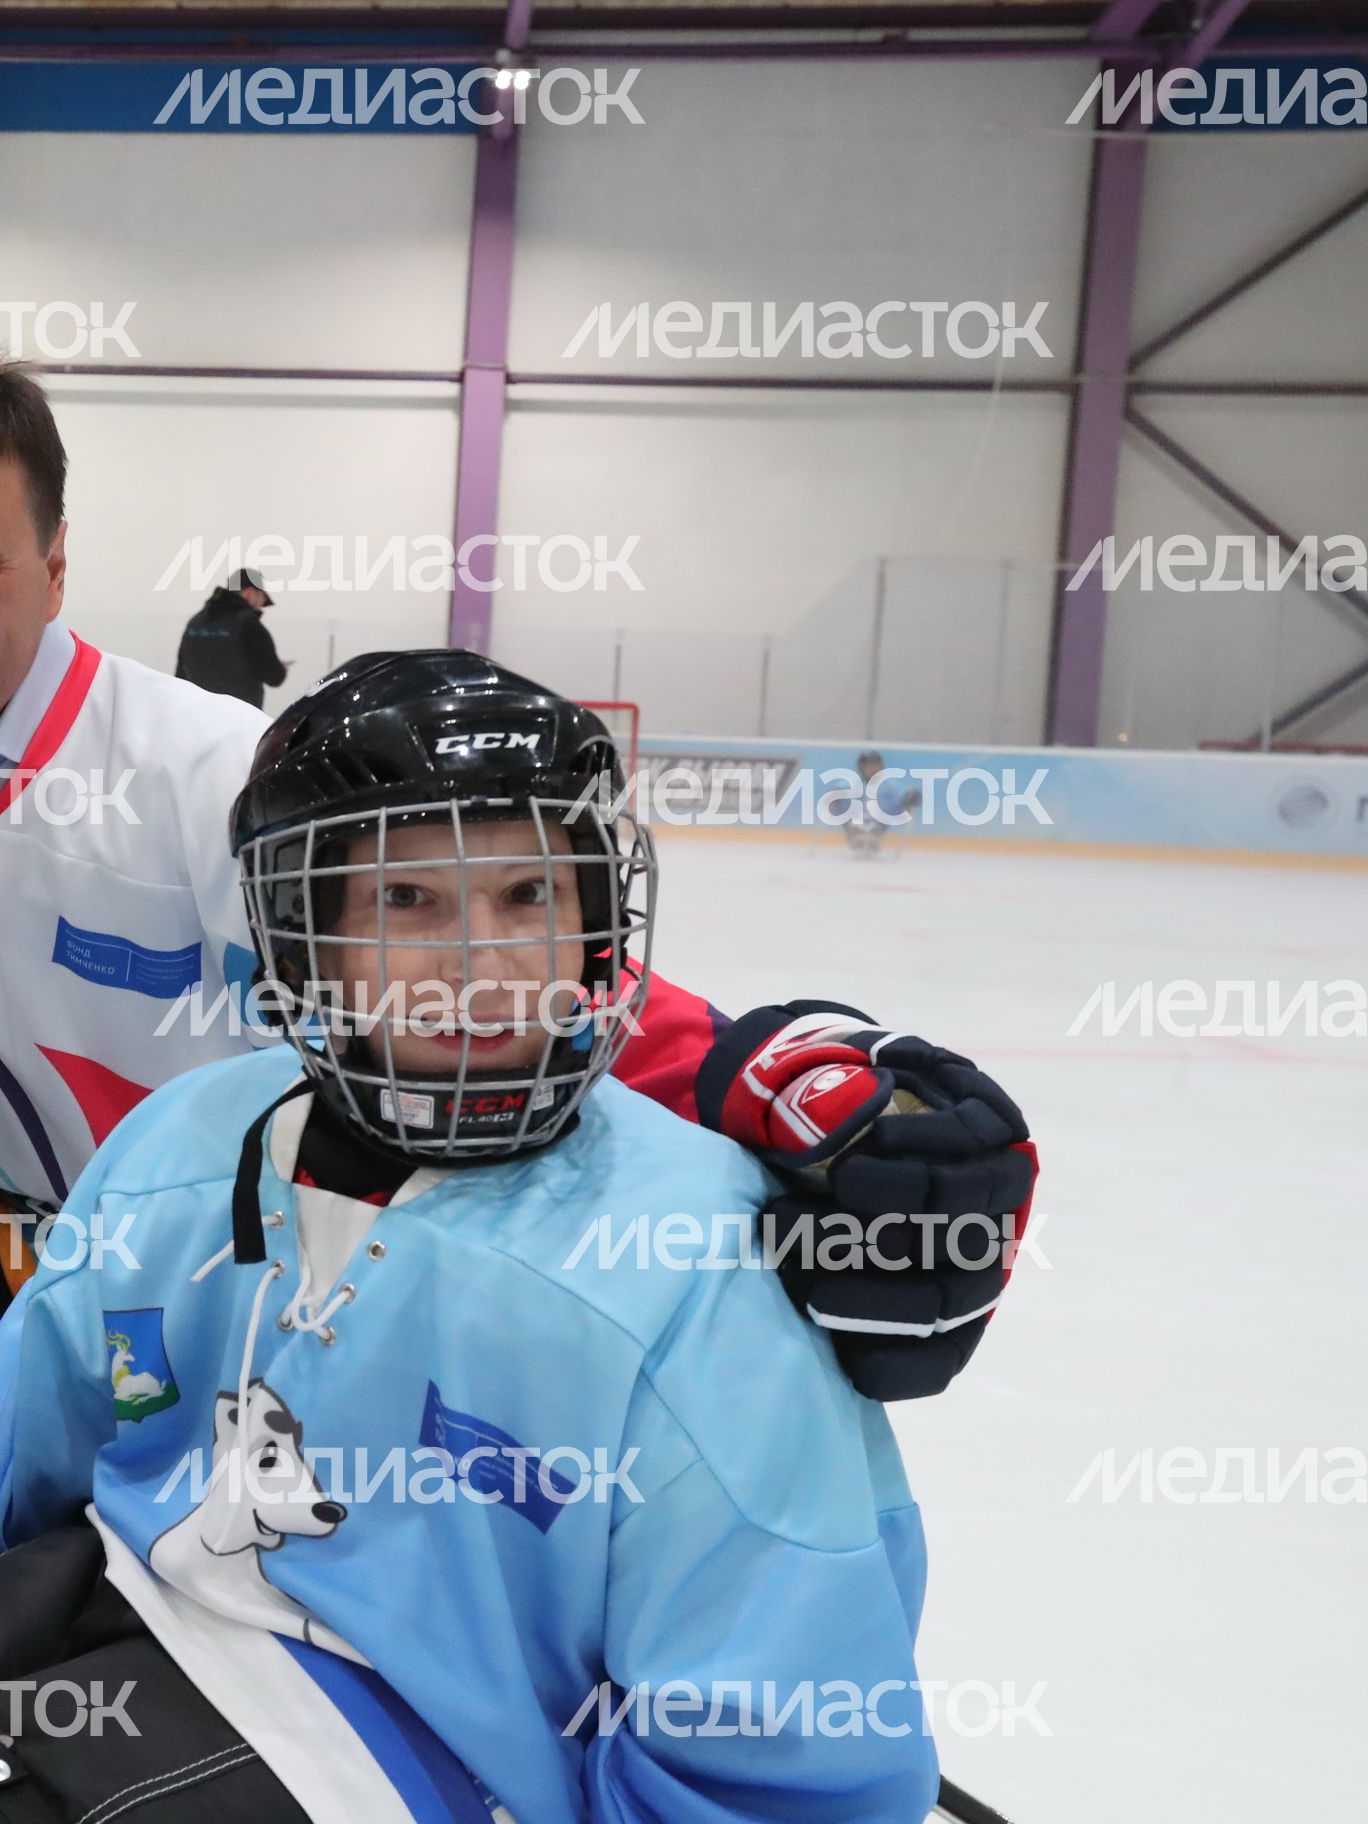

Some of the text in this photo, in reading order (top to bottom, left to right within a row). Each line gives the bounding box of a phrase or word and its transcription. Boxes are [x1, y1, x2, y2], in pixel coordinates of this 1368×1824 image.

[435, 732, 541, 755] CCM
[66, 940, 91, 959] ФОНД
[65, 950, 115, 976] ТИМЧЕНКО
[444, 1091, 525, 1114] CCM
